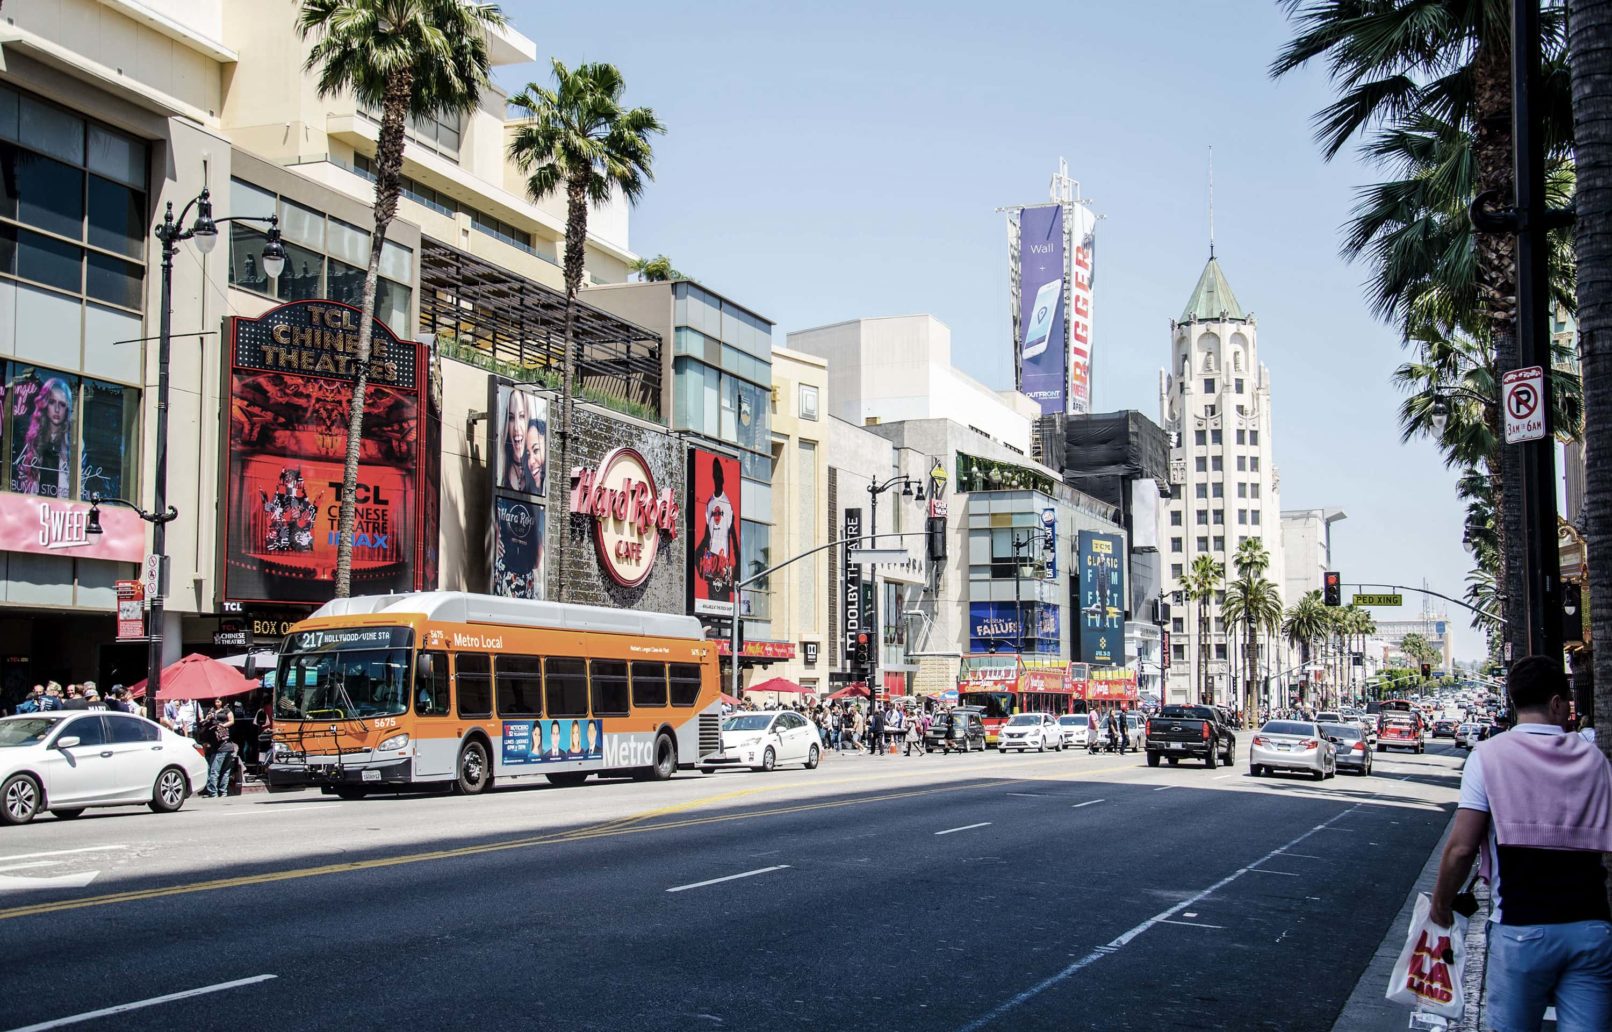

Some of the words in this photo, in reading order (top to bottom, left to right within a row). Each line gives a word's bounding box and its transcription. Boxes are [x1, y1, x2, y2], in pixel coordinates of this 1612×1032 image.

[1030, 243, 1054, 253] Wall
[308, 305, 358, 331] TCL
[273, 324, 387, 358] CHINEE
[261, 345, 398, 382] THEATES
[1026, 390, 1061, 399] OUTFRONT
[329, 482, 389, 505] TCL
[571, 467, 633, 521] Hard
[328, 505, 389, 521] CNESE
[632, 480, 679, 540] Rock
[328, 519, 388, 533] TATRE
[615, 540, 642, 560] CAFE
[1087, 556, 1118, 569] CLASIC
[1087, 569, 1118, 585] FM
[224, 602, 242, 611] TCL
[847, 584, 858, 629] DOLBY
[1356, 596, 1374, 604] PED
[1377, 596, 1398, 604] XING
[254, 620, 277, 635] BOX
[430, 630, 444, 639] 5675
[976, 621, 1022, 636] FAILUR
[302, 632, 324, 648] 217
[324, 632, 377, 643] HOLLYWOOD/VINE
[378, 631, 390, 640] STA
[453, 632, 480, 647] Metro
[481, 635, 503, 649] Local
[374, 718, 396, 727] 5675
[602, 733, 653, 768] Metro
[1414, 929, 1454, 959] LA
[1408, 953, 1453, 993] LA
[1407, 975, 1453, 1003] LAND
